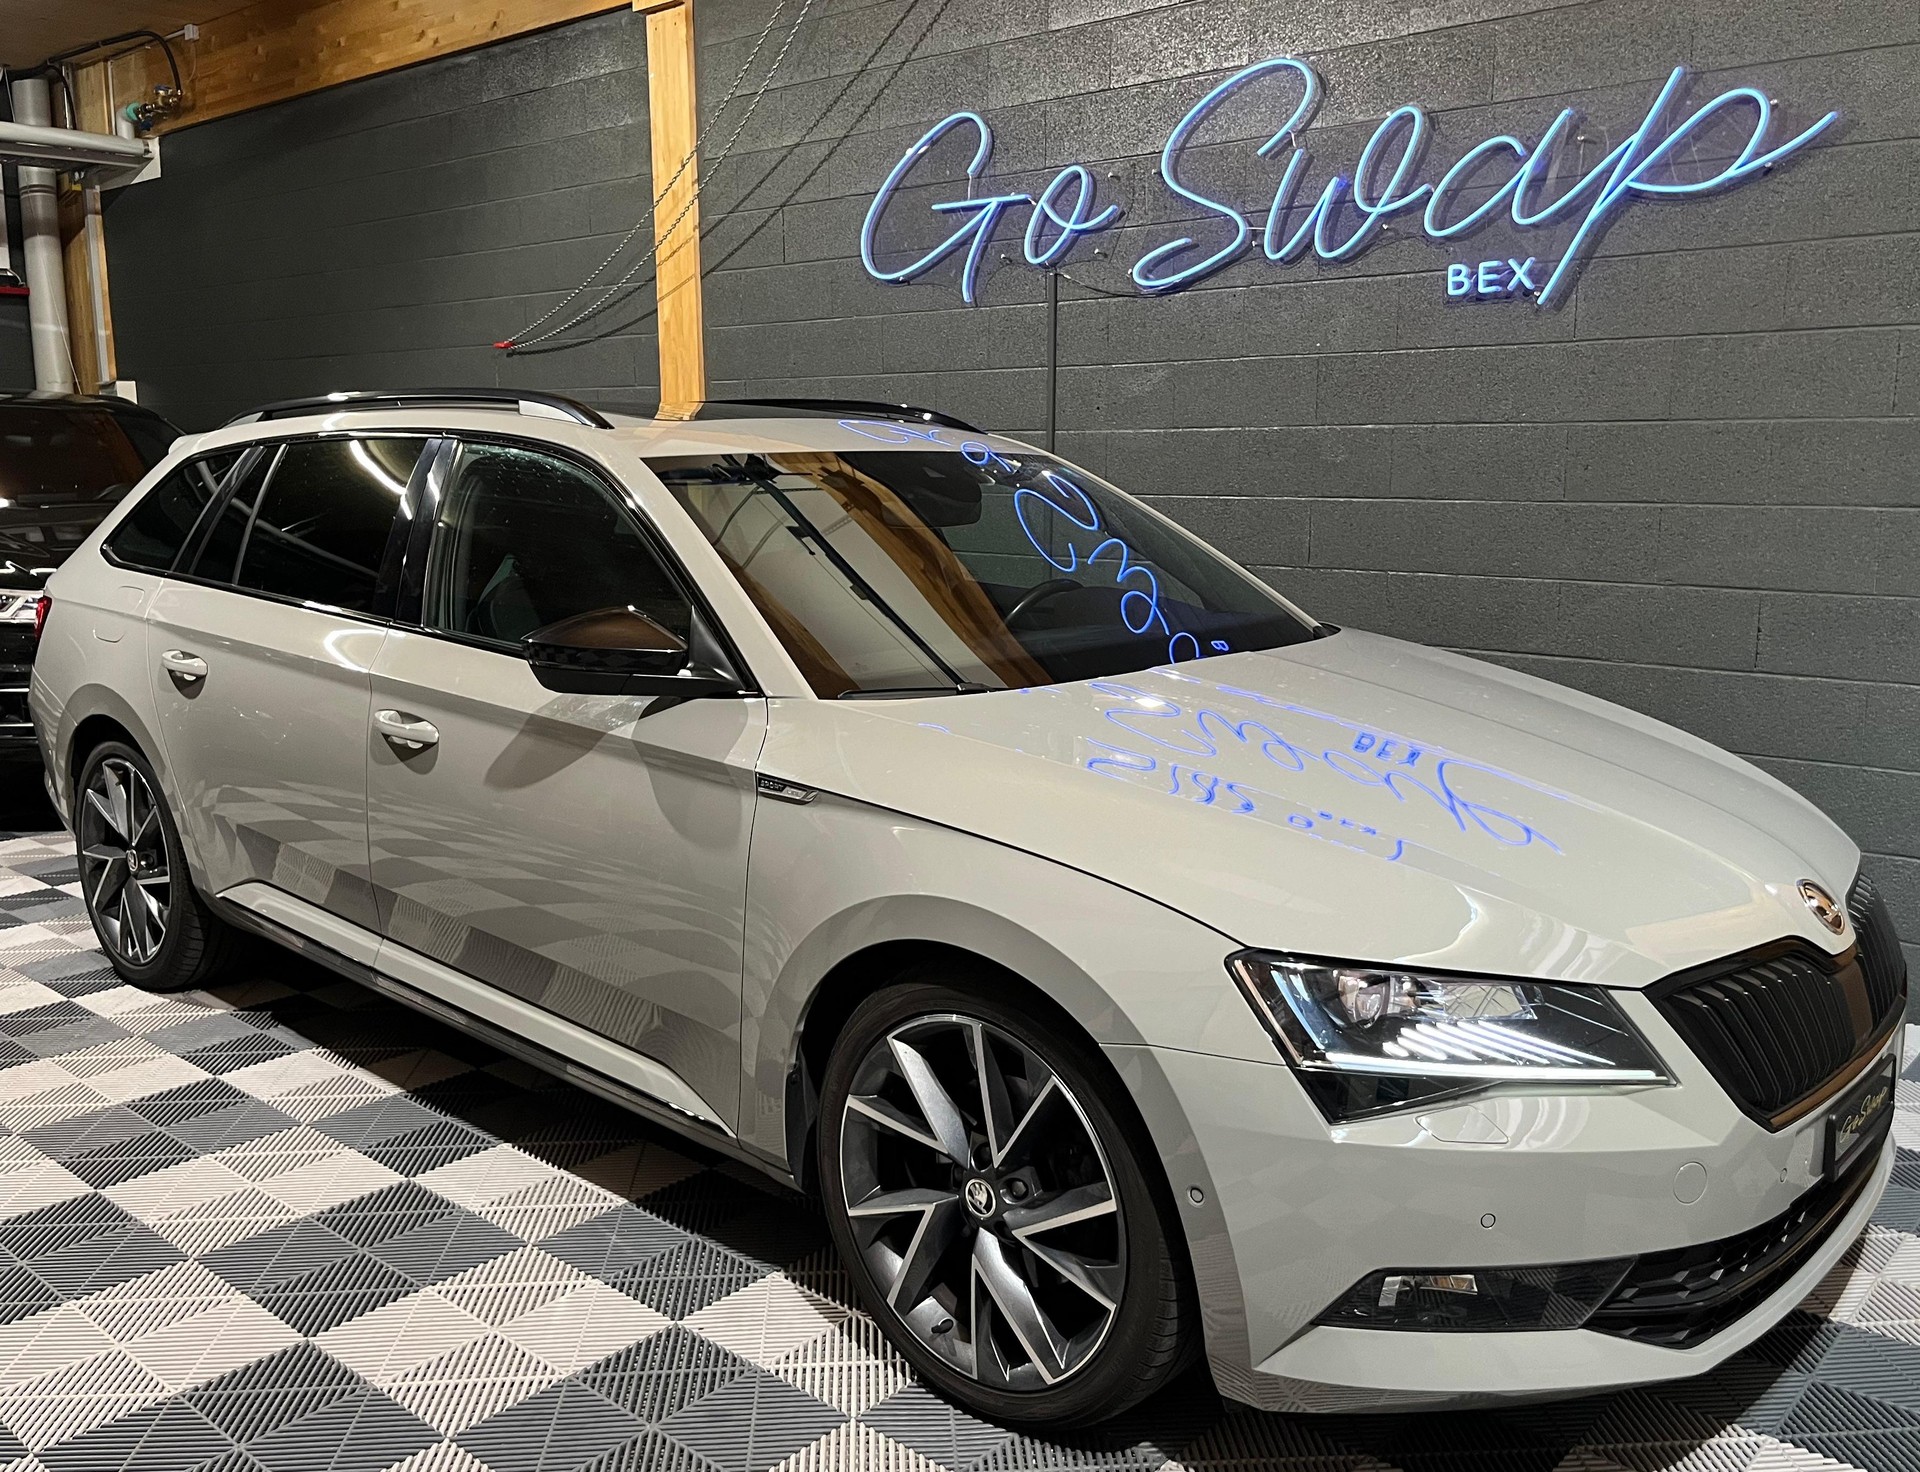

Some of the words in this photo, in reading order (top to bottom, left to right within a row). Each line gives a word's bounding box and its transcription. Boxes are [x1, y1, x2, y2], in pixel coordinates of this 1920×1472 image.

[860, 111, 1120, 303] Go
[1129, 57, 1839, 306] Swap
[1446, 256, 1536, 296] BEX
